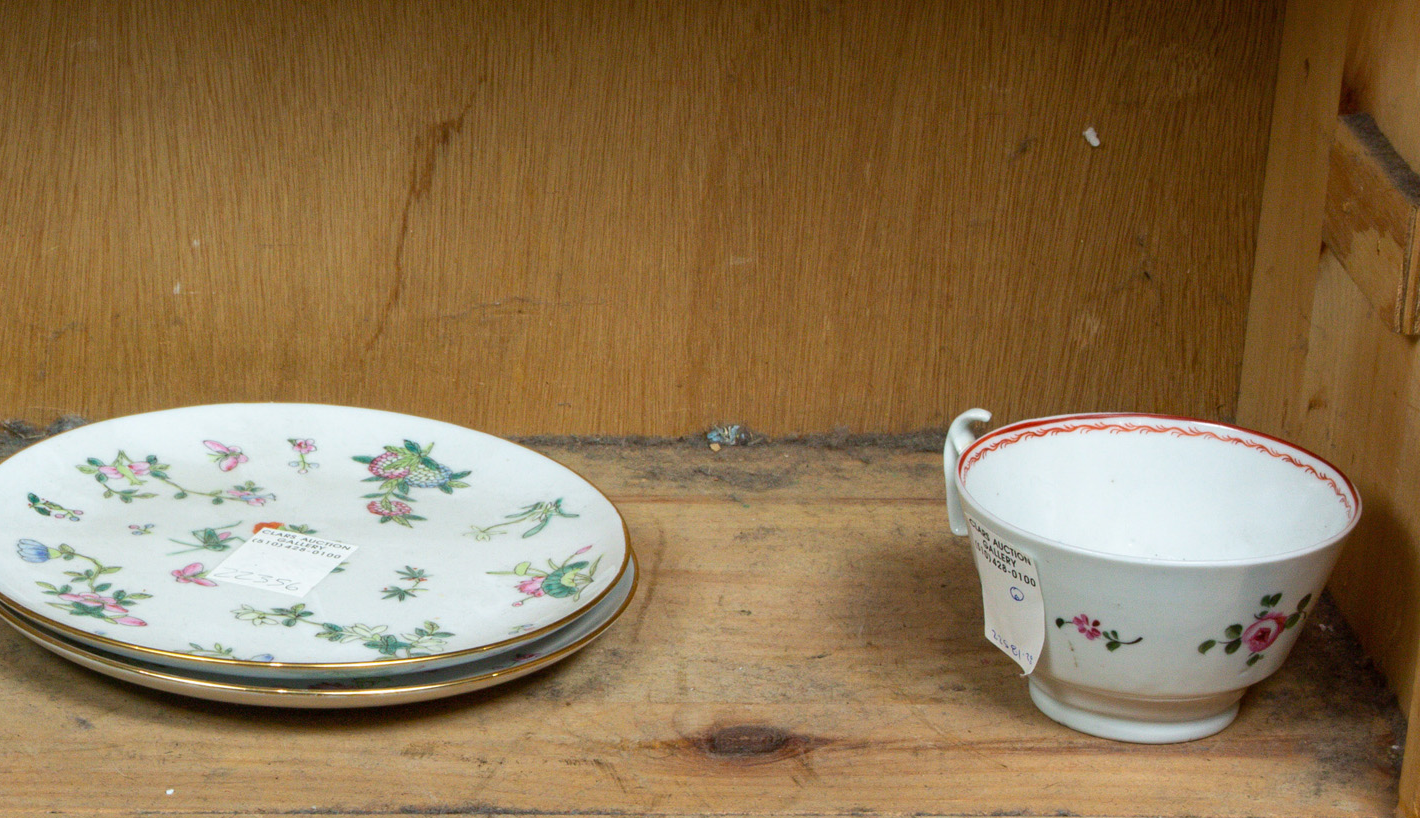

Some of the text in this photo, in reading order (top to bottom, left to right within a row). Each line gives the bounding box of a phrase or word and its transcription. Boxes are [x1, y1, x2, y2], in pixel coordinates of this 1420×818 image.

[252, 538, 342, 559] (510)428-0100
[261, 529, 352, 551] CLARS AUCTION
[277, 538, 326, 551] GALLERY
[969, 518, 1032, 566] CLARS AUCTION
[982, 540, 1017, 568] GALLERY
